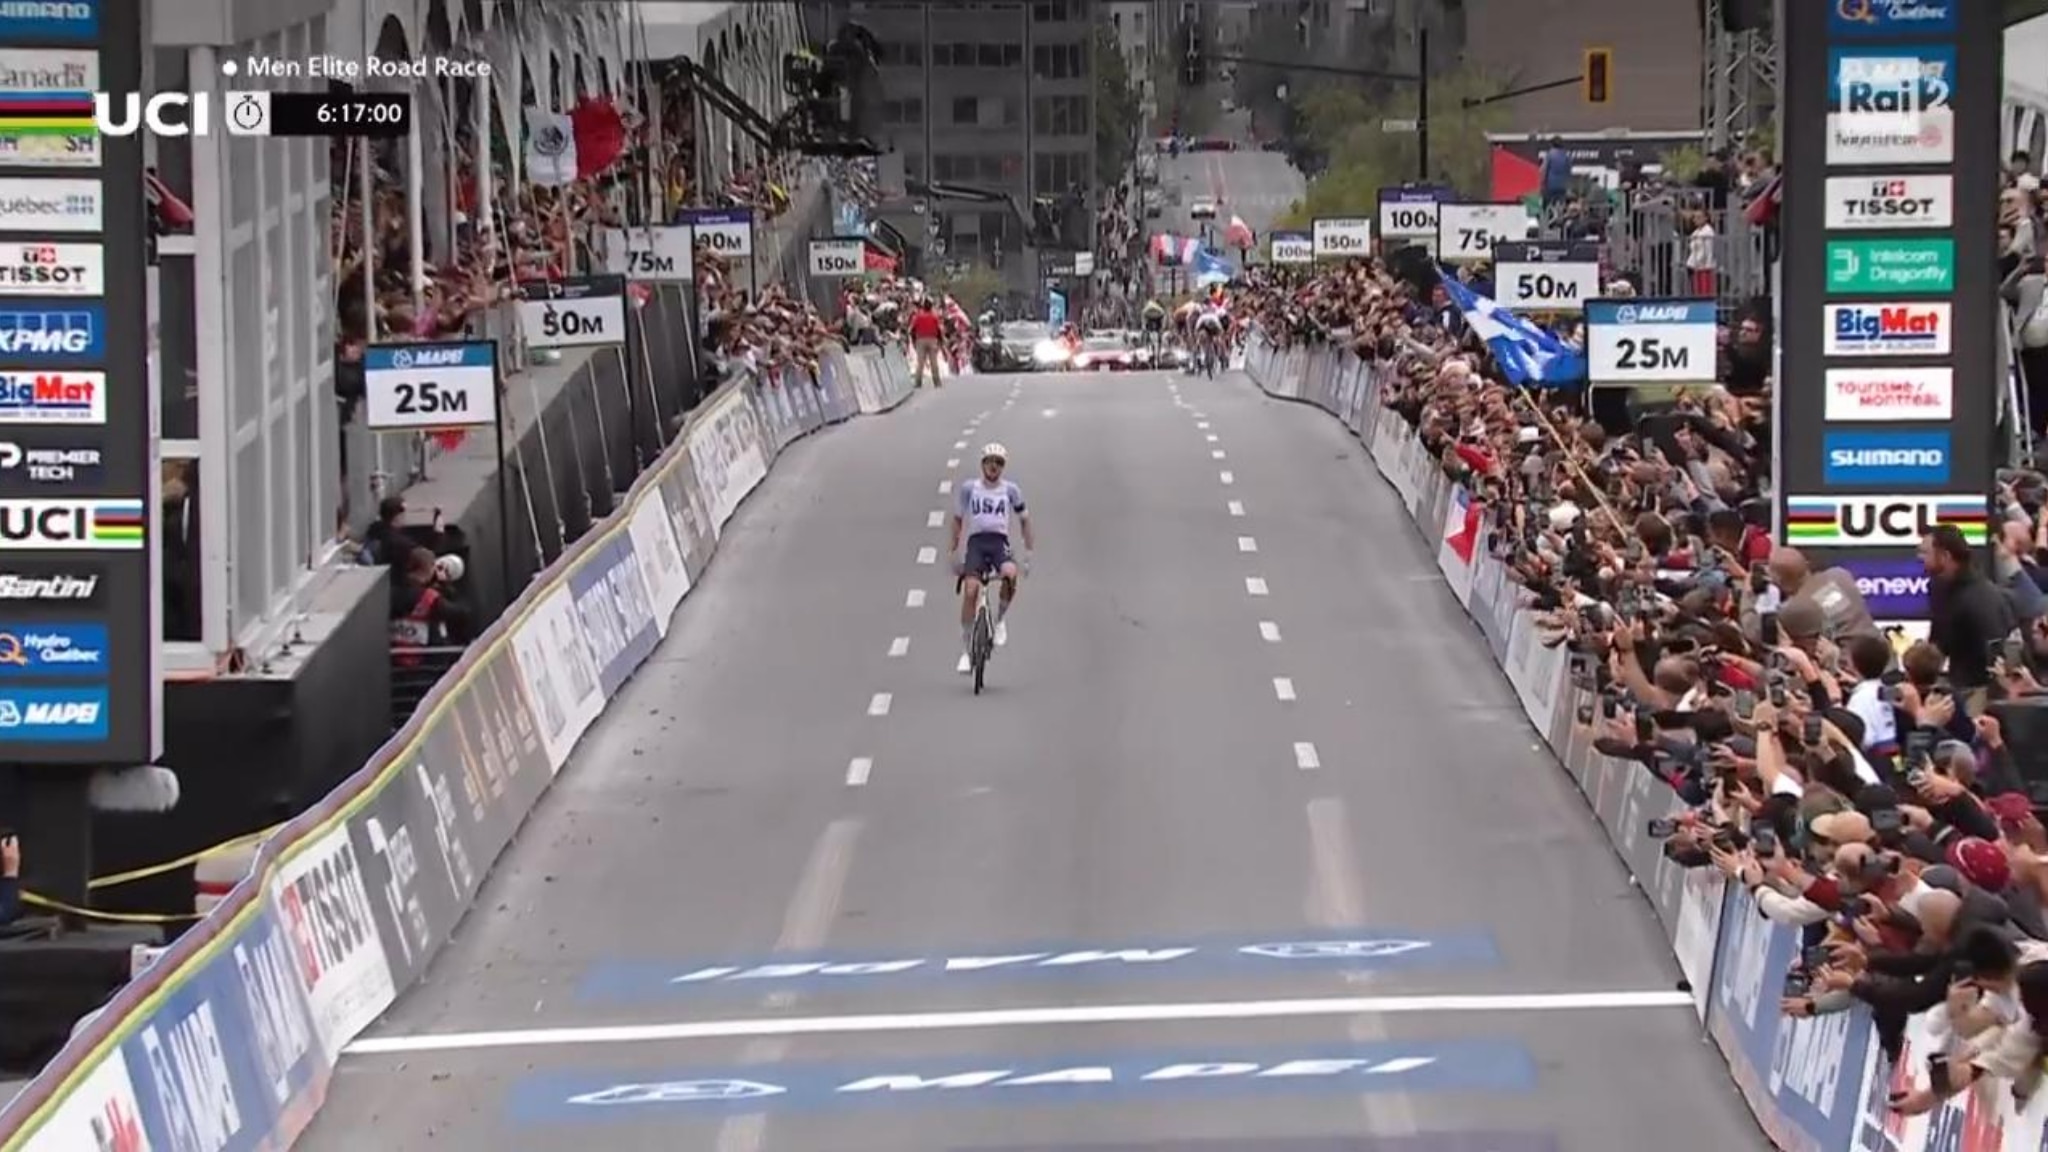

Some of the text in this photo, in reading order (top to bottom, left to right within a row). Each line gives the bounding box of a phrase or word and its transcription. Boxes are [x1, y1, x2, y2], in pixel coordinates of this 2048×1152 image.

[1844, 198, 1934, 215] TISSOT
[1322, 234, 1362, 250] 150M
[627, 250, 673, 273] 75M
[817, 256, 857, 270] 150M
[1869, 266, 1947, 283] Dragonfly
[1518, 273, 1577, 299] 50M
[1639, 306, 1689, 320] MAPEI
[543, 310, 603, 336] 50M
[1835, 308, 1939, 341] BigMat
[415, 350, 465, 364] MAPEI
[1615, 338, 1689, 369] 25M
[394, 383, 467, 413] 25M
[27, 450, 100, 465] PREMIER
[1830, 449, 1943, 467] SHIMANO
[29, 466, 74, 480] TECH
[972, 498, 1006, 515] USA
[0, 507, 86, 540] UCI
[1841, 503, 1928, 537] UCI
[0, 574, 98, 599] Santini
[23, 633, 71, 651] Hydro
[23, 702, 101, 724] MAPEI
